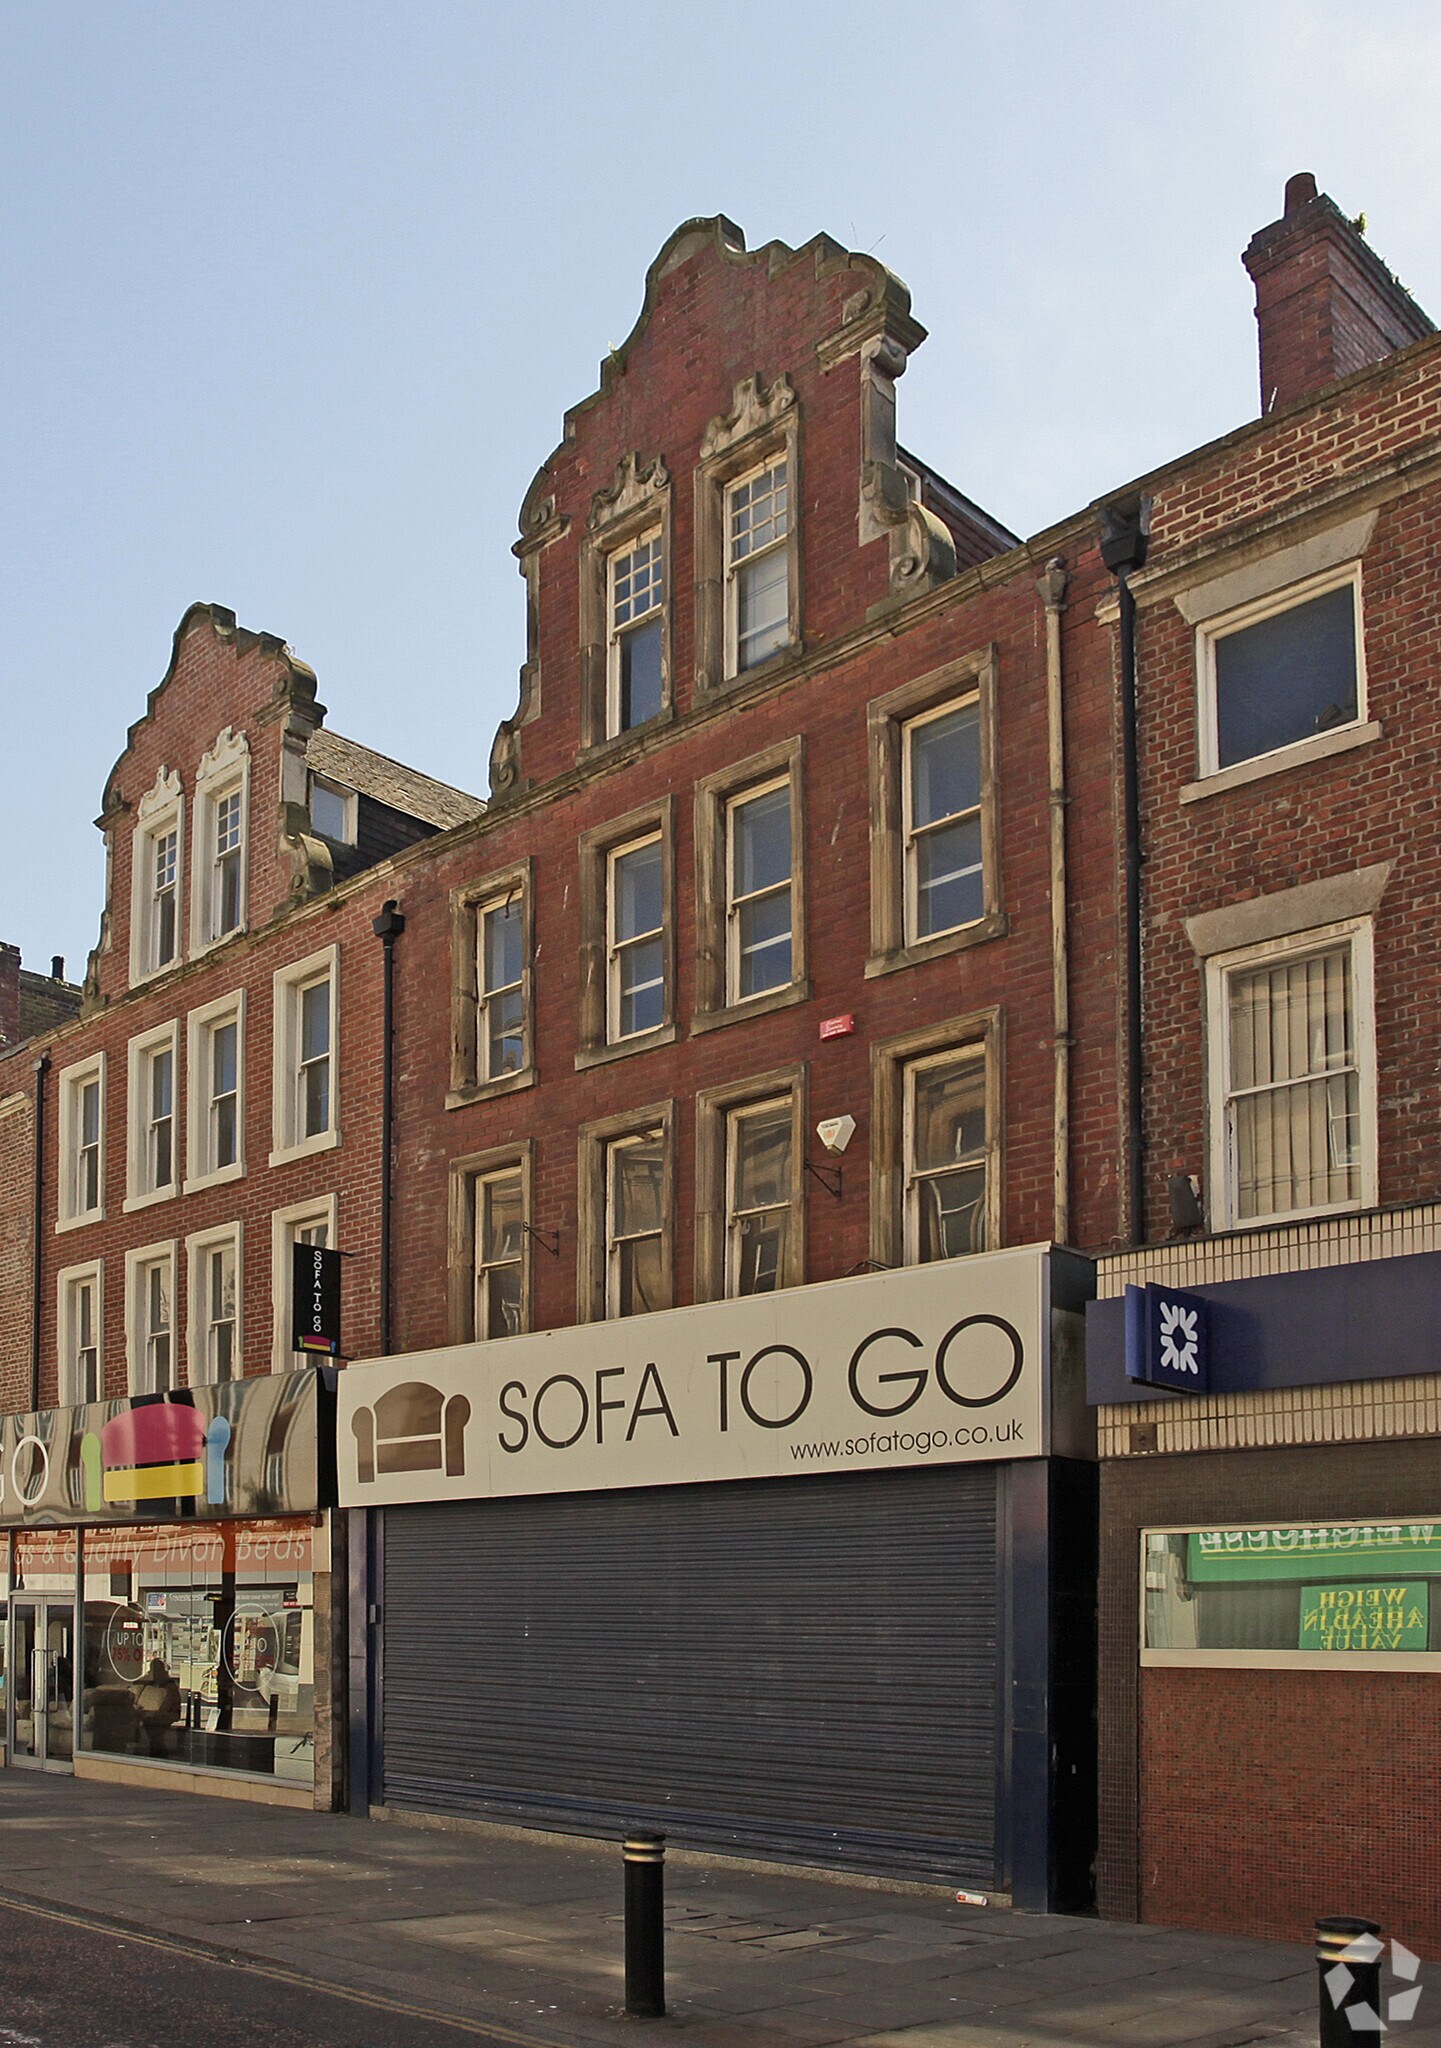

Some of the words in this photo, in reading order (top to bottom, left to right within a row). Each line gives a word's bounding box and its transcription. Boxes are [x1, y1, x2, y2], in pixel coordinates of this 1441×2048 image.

[313, 1251, 322, 1289] SOFA
[313, 1293, 322, 1312] TO
[313, 1315, 322, 1332] GO
[498, 1363, 679, 1453] SOFA
[707, 1344, 813, 1432] TO
[848, 1314, 1024, 1418] GO
[790, 1419, 1023, 1460] www.sofatogo.co.uk
[42, 1537, 55, 1565] &
[153, 1533, 226, 1563] Divan
[236, 1529, 306, 1562] Beds
[117, 1632, 129, 1646] UP
[131, 1632, 144, 1647] TO
